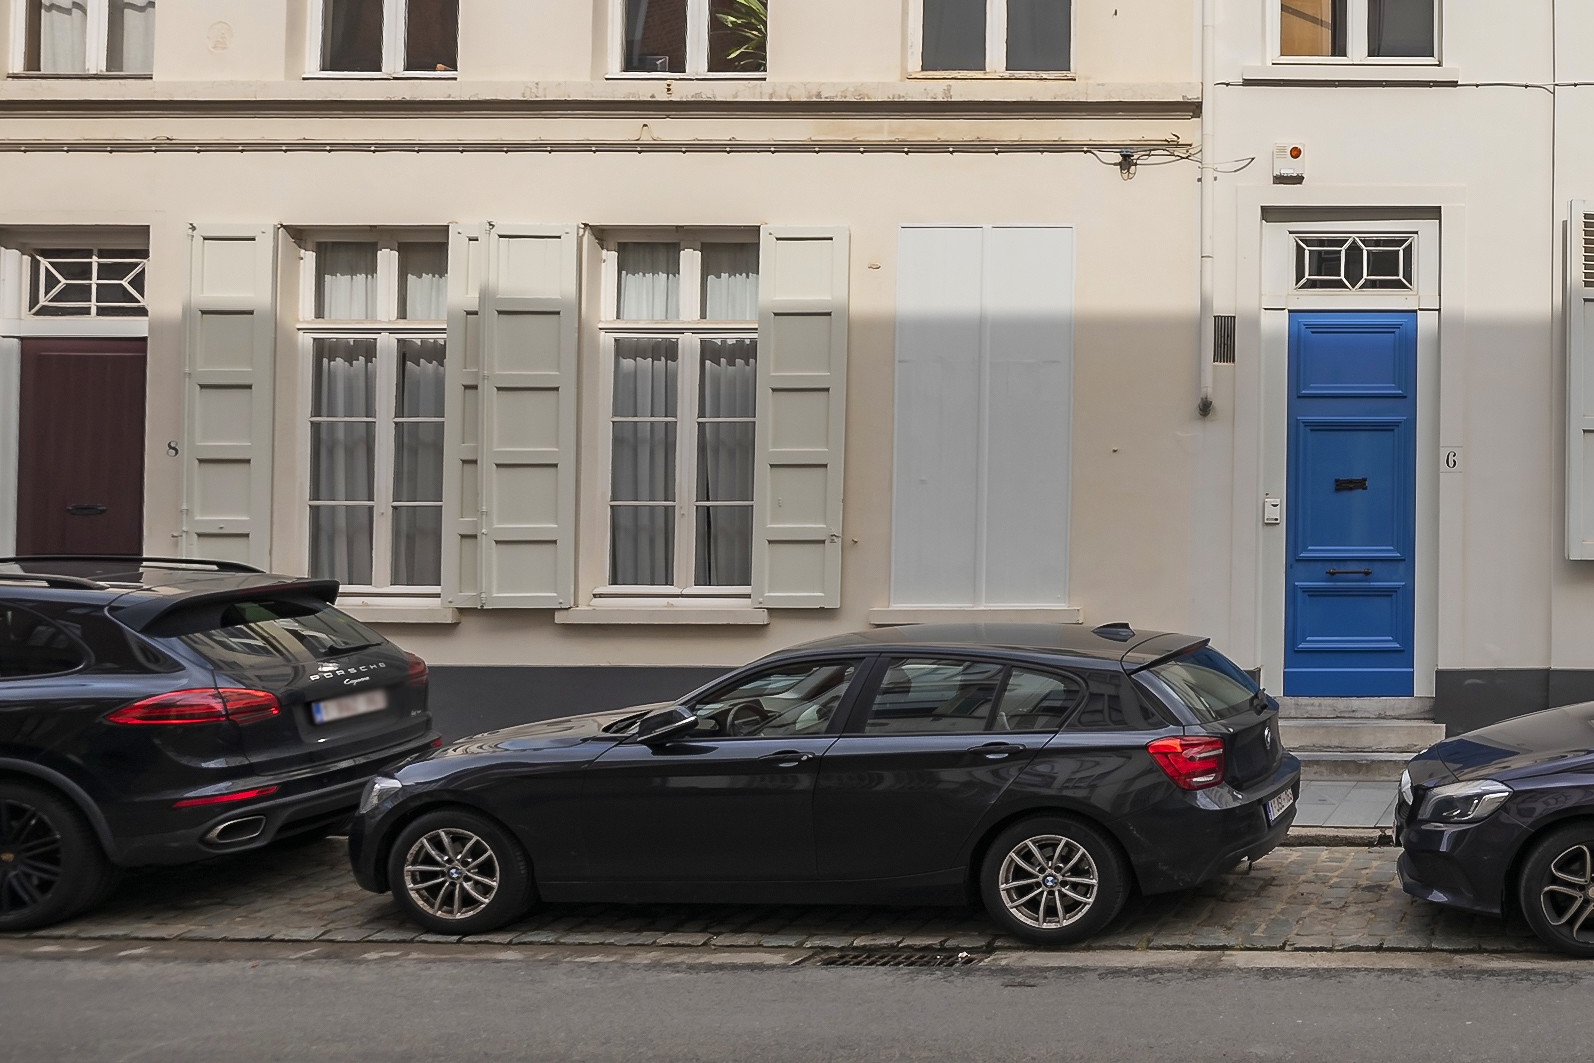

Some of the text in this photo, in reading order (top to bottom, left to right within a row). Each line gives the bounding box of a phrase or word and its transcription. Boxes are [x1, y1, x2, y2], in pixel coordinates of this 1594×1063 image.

[167, 440, 178, 457] 8
[1446, 451, 1457, 468] 6
[309, 662, 386, 681] PORSCHE
